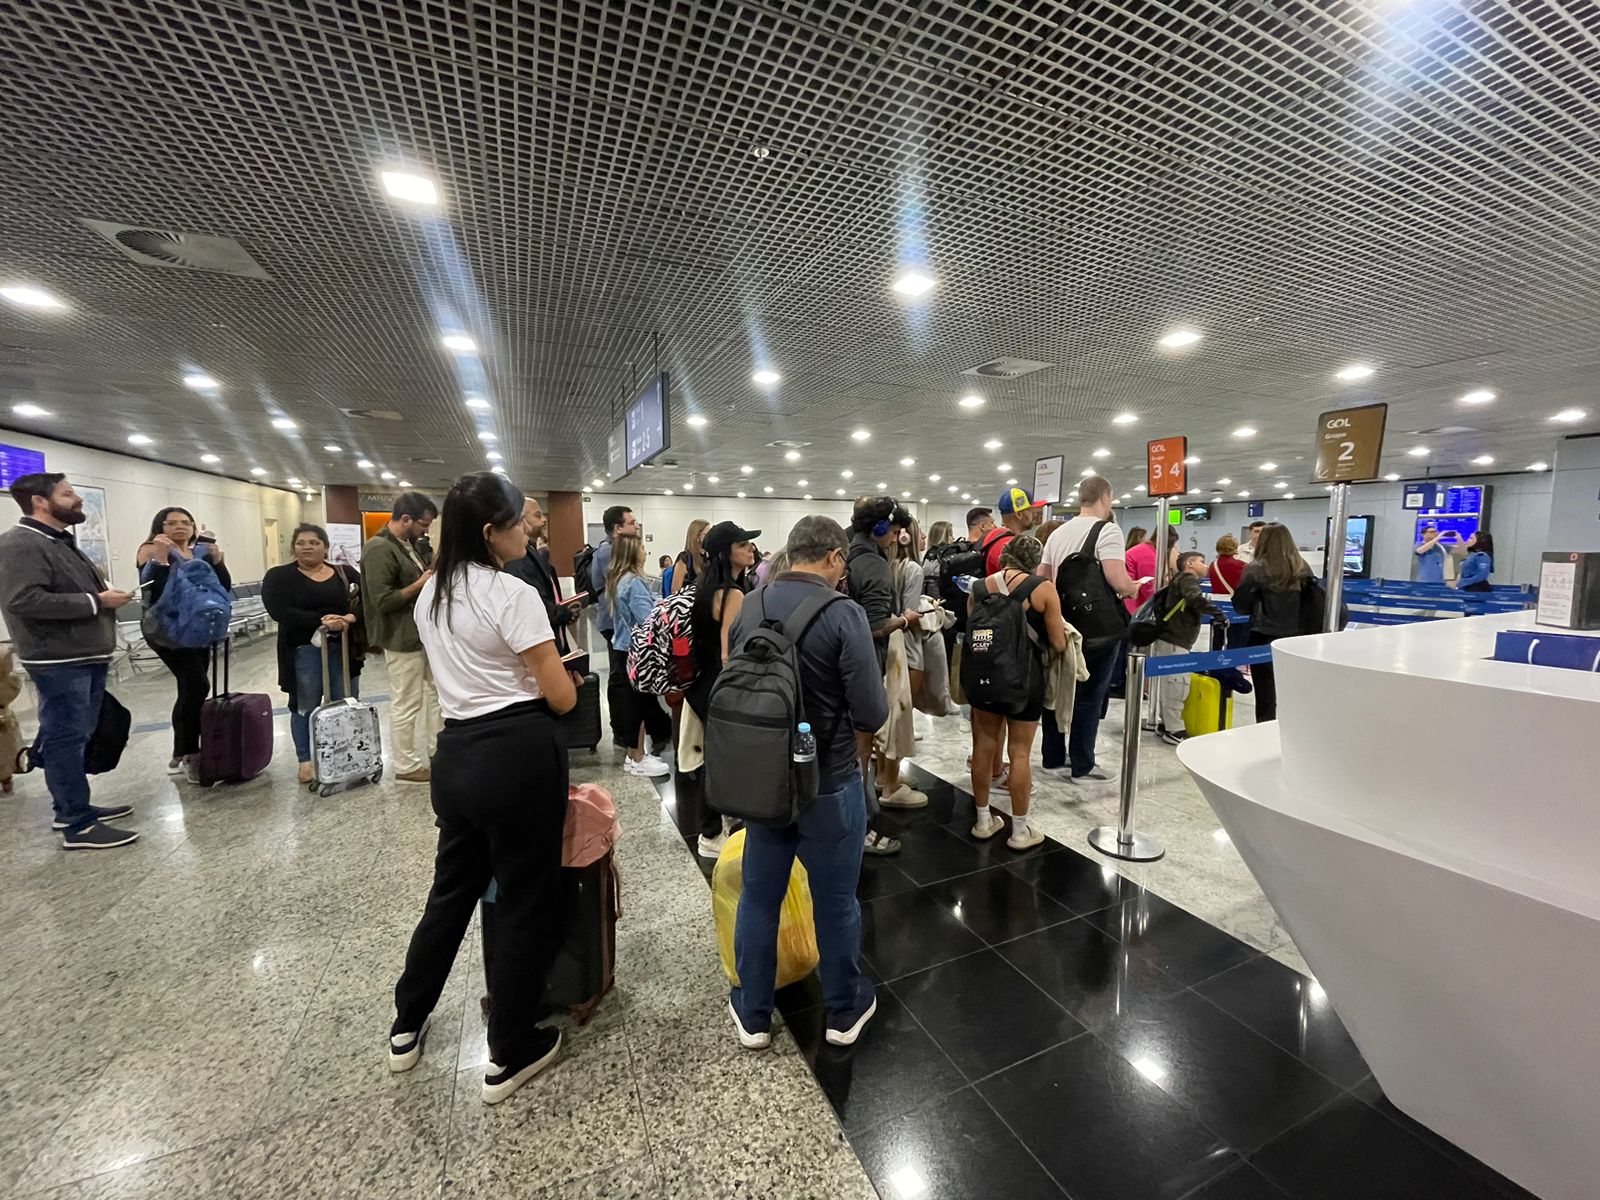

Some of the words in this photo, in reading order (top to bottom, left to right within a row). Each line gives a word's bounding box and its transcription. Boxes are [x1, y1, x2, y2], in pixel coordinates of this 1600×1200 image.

[1326, 417, 1351, 430] GOL
[1151, 444, 1166, 453] GOL
[1338, 441, 1355, 461] 2
[1152, 464, 1162, 479] 3
[1169, 462, 1180, 477] 4
